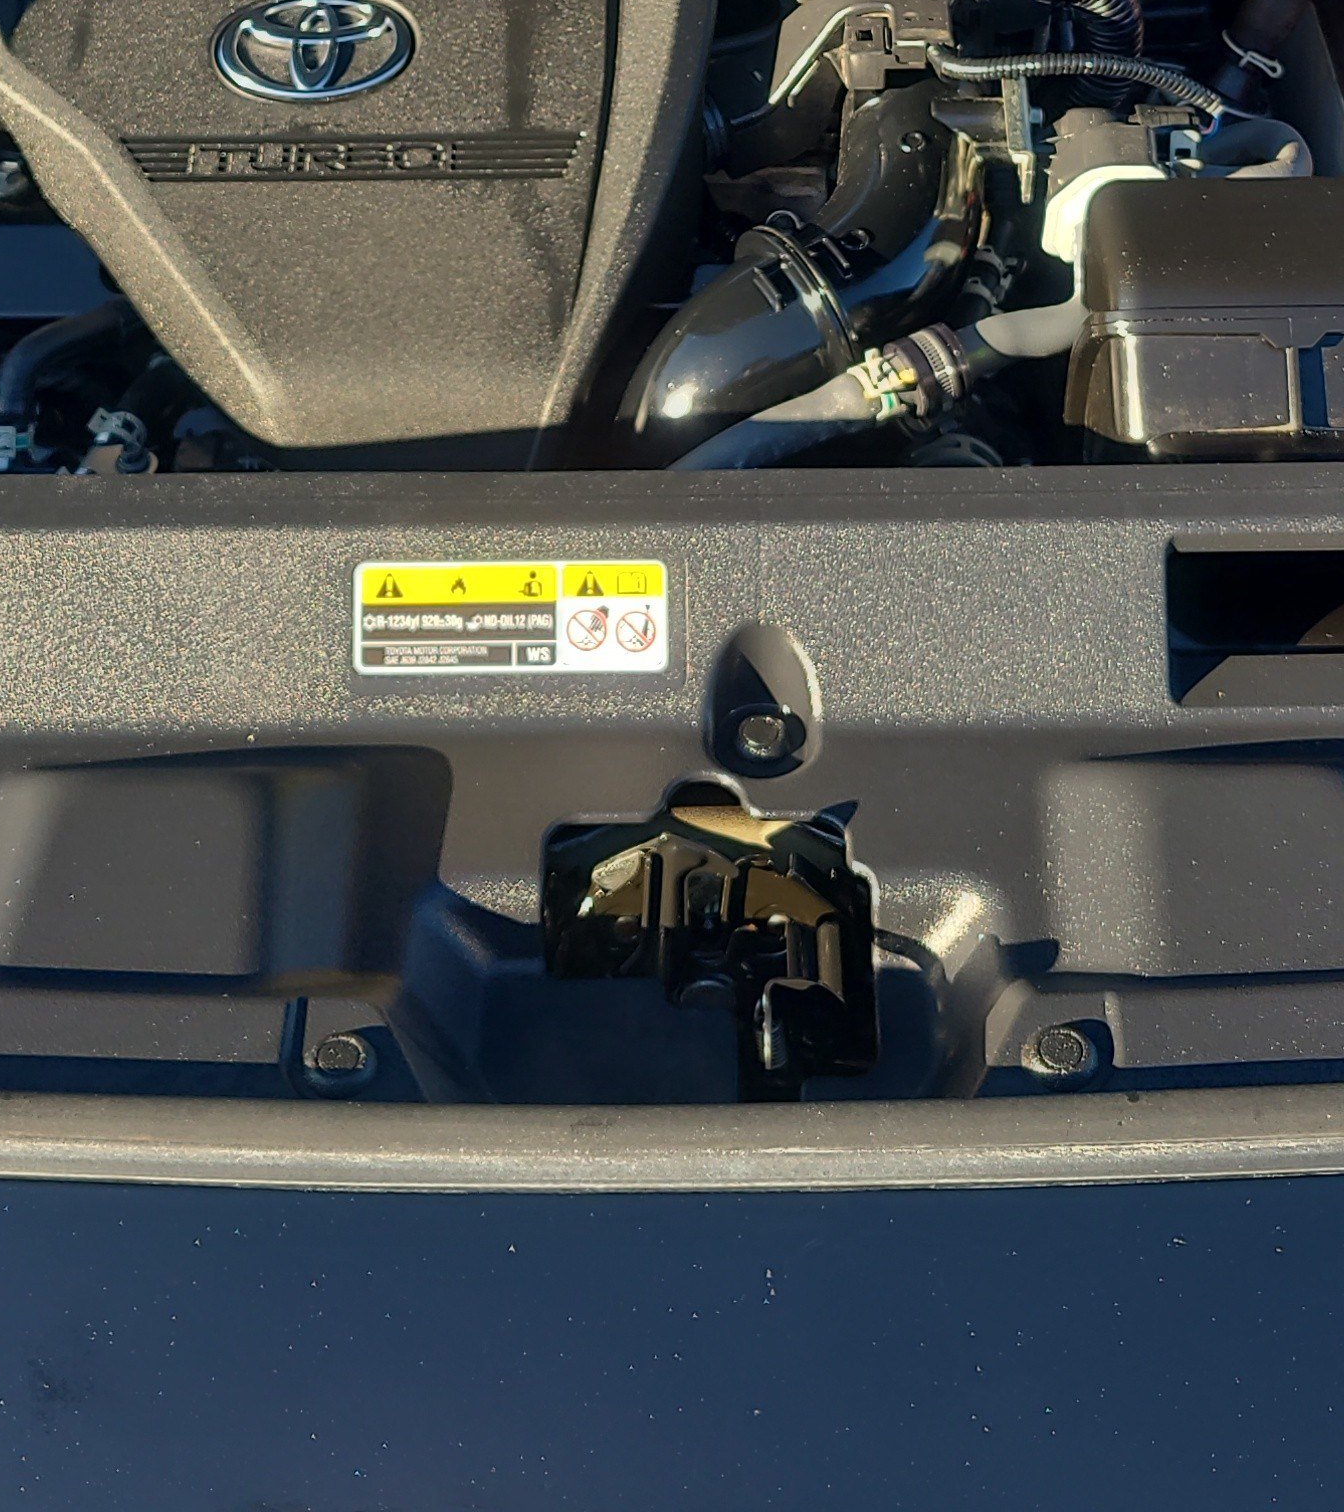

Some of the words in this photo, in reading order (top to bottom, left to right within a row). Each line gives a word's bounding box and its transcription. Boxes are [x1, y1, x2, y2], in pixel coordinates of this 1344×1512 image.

[186, 142, 448, 175] TURBO
[527, 614, 553, 630] (PAG)
[385, 646, 413, 655] TOYOTA
[414, 646, 438, 655] MOTOR
[526, 648, 552, 662] WS
